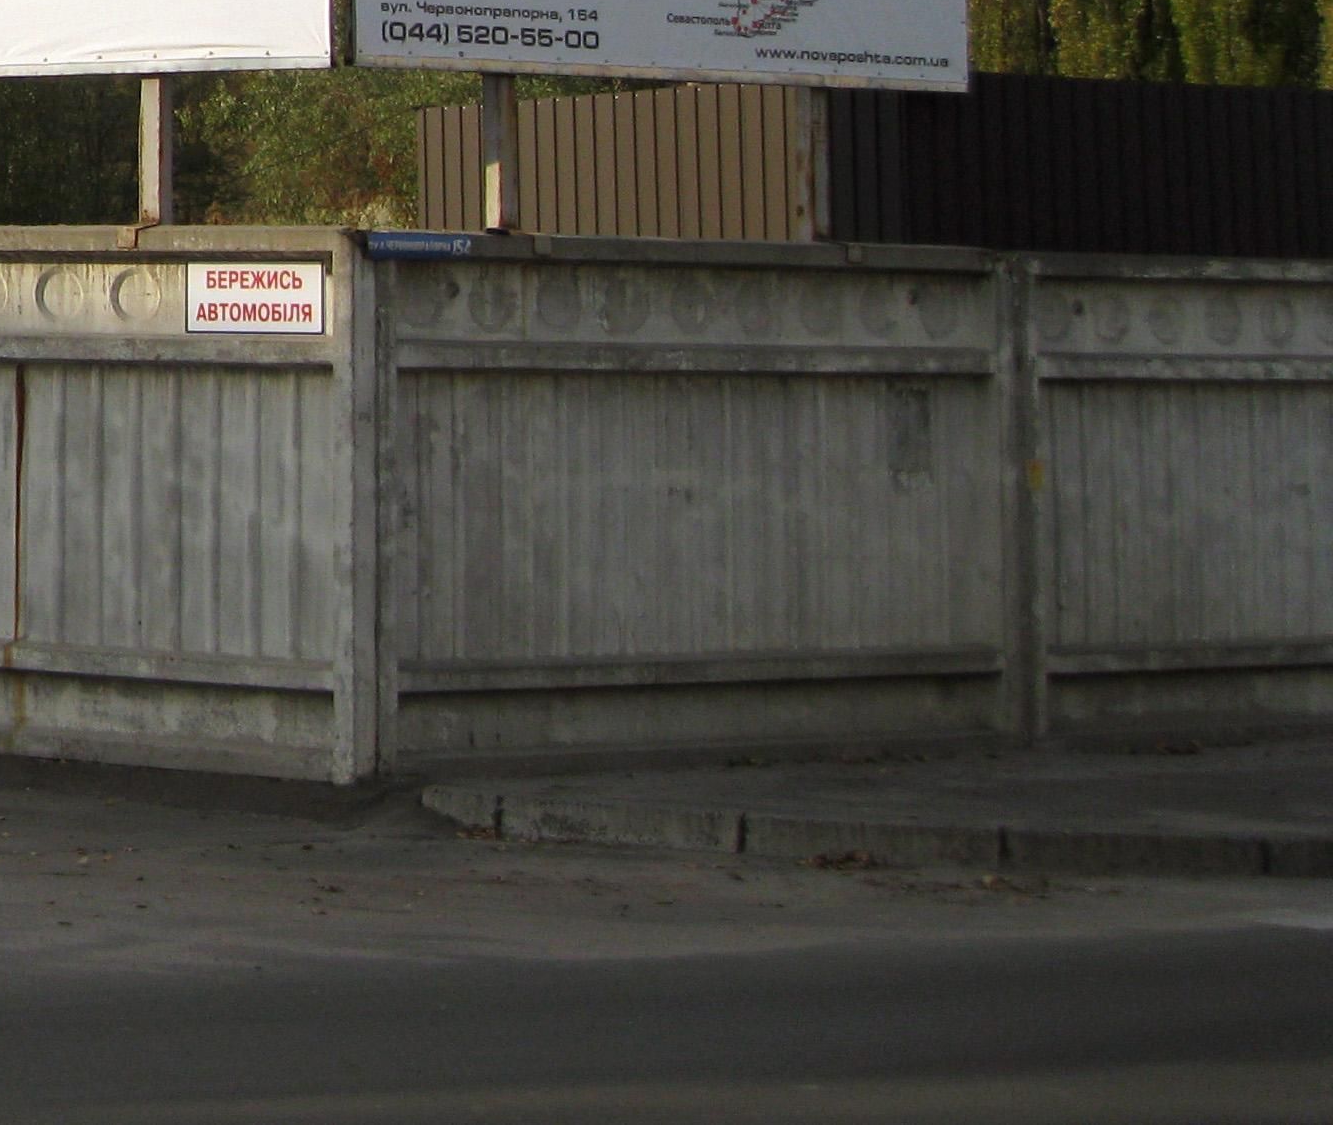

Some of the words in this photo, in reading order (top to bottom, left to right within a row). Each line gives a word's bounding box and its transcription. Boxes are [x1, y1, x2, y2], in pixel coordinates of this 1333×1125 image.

[381, 1, 412, 15] вул.
[666, 13, 731, 27] Севастополь
[381, 20, 450, 45] (044)
[457, 25, 600, 49] 520-55-00
[754, 47, 949, 68] www.novaposhta.com.ua
[205, 270, 303, 290] БЕРЕЖИСЬ
[195, 303, 313, 323] АВТОМОБІЛЯ
